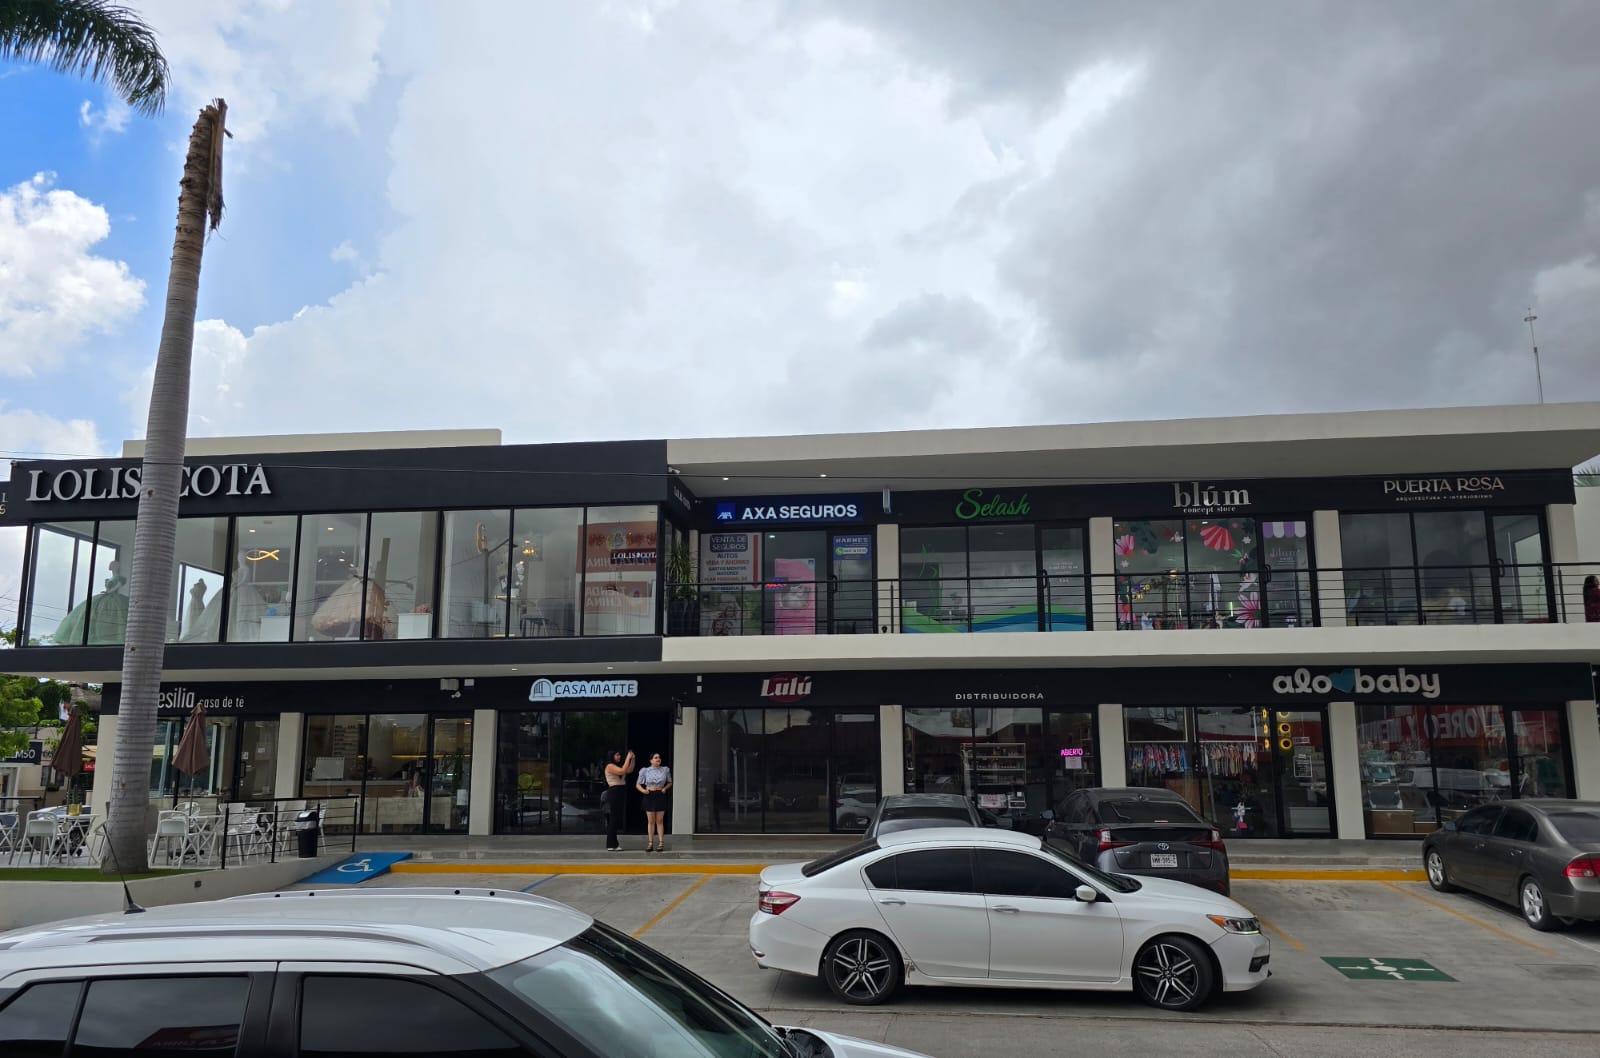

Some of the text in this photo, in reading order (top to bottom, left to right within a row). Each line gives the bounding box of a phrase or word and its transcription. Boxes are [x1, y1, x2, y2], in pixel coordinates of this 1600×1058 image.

[25, 467, 142, 502] LOLIS
[1383, 476, 1505, 494] PUERTA ROSA
[955, 488, 1031, 520] Selash
[1172, 481, 1252, 508] blúm
[717, 511, 733, 520] AXA
[741, 504, 858, 520] AXA SEGUROS
[1183, 505, 1237, 516] concept store
[554, 682, 637, 696] CASA MATTE
[760, 676, 813, 697] Lulú
[1272, 667, 1441, 699] alo baby
[158, 687, 195, 709] esilia
[222, 695, 233, 708] de
[955, 692, 1044, 700] DISTRIBUIDORA
